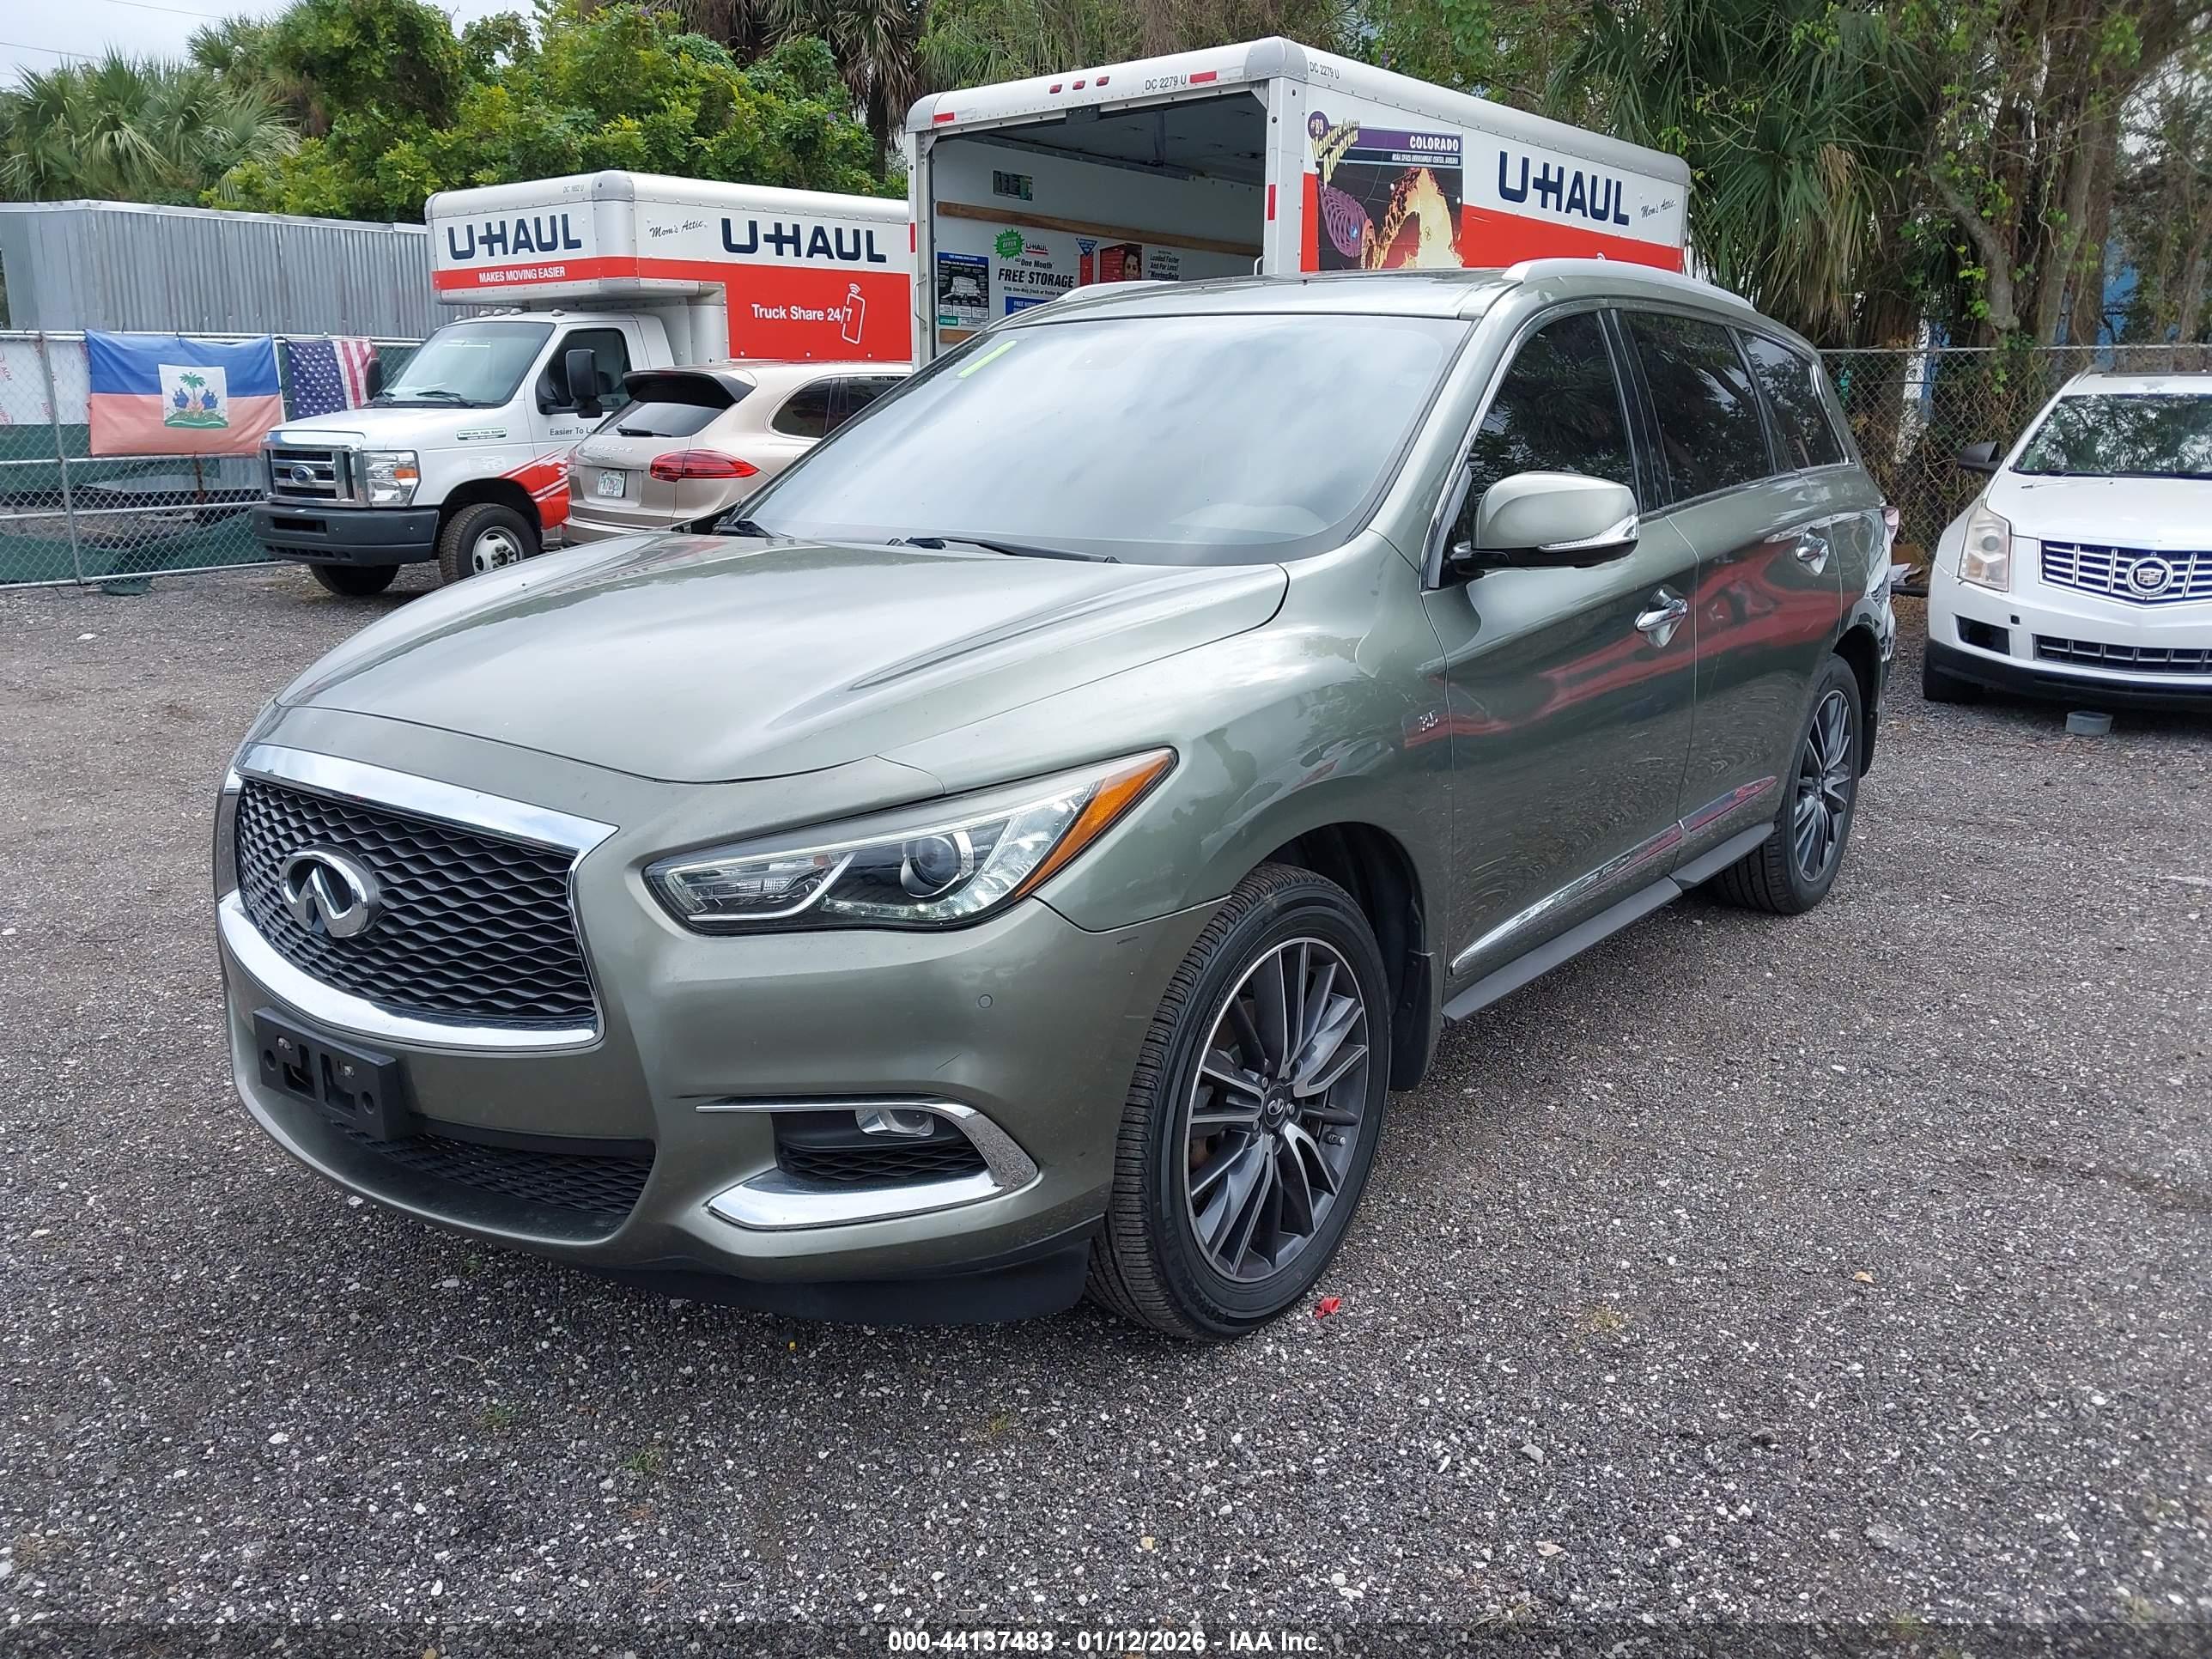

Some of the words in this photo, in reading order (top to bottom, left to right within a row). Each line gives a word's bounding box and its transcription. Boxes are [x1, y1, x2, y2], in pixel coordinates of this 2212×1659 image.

[1310, 61, 1319, 74] DC
[1320, 64, 1334, 77] 2279
[1335, 68, 1340, 79] U
[1145, 78, 1158, 90] DC
[1159, 76, 1178, 88] 2279
[1181, 73, 1187, 85] U
[1310, 118, 1324, 135] #89
[1311, 126, 1342, 162] Venture
[1409, 135, 1459, 152] COLORADO
[1322, 130, 1358, 192] America
[1498, 150, 1630, 227] U-HAUL
[1640, 204, 1659, 219] Mom's
[447, 213, 582, 260] U-HAUL
[649, 225, 679, 239] Mom's
[720, 217, 887, 264] U-HAUL
[1021, 258, 1032, 267] One
[479, 271, 505, 283] MAKES
[506, 268, 538, 282] MOVING
[538, 266, 566, 279] EASIER
[998, 268, 1025, 283] FREE
[1028, 271, 1074, 289] STORAGE
[751, 303, 787, 320] Truck
[790, 306, 824, 321] Share
[826, 306, 853, 325] 24/7
[550, 428, 573, 436] Easier
